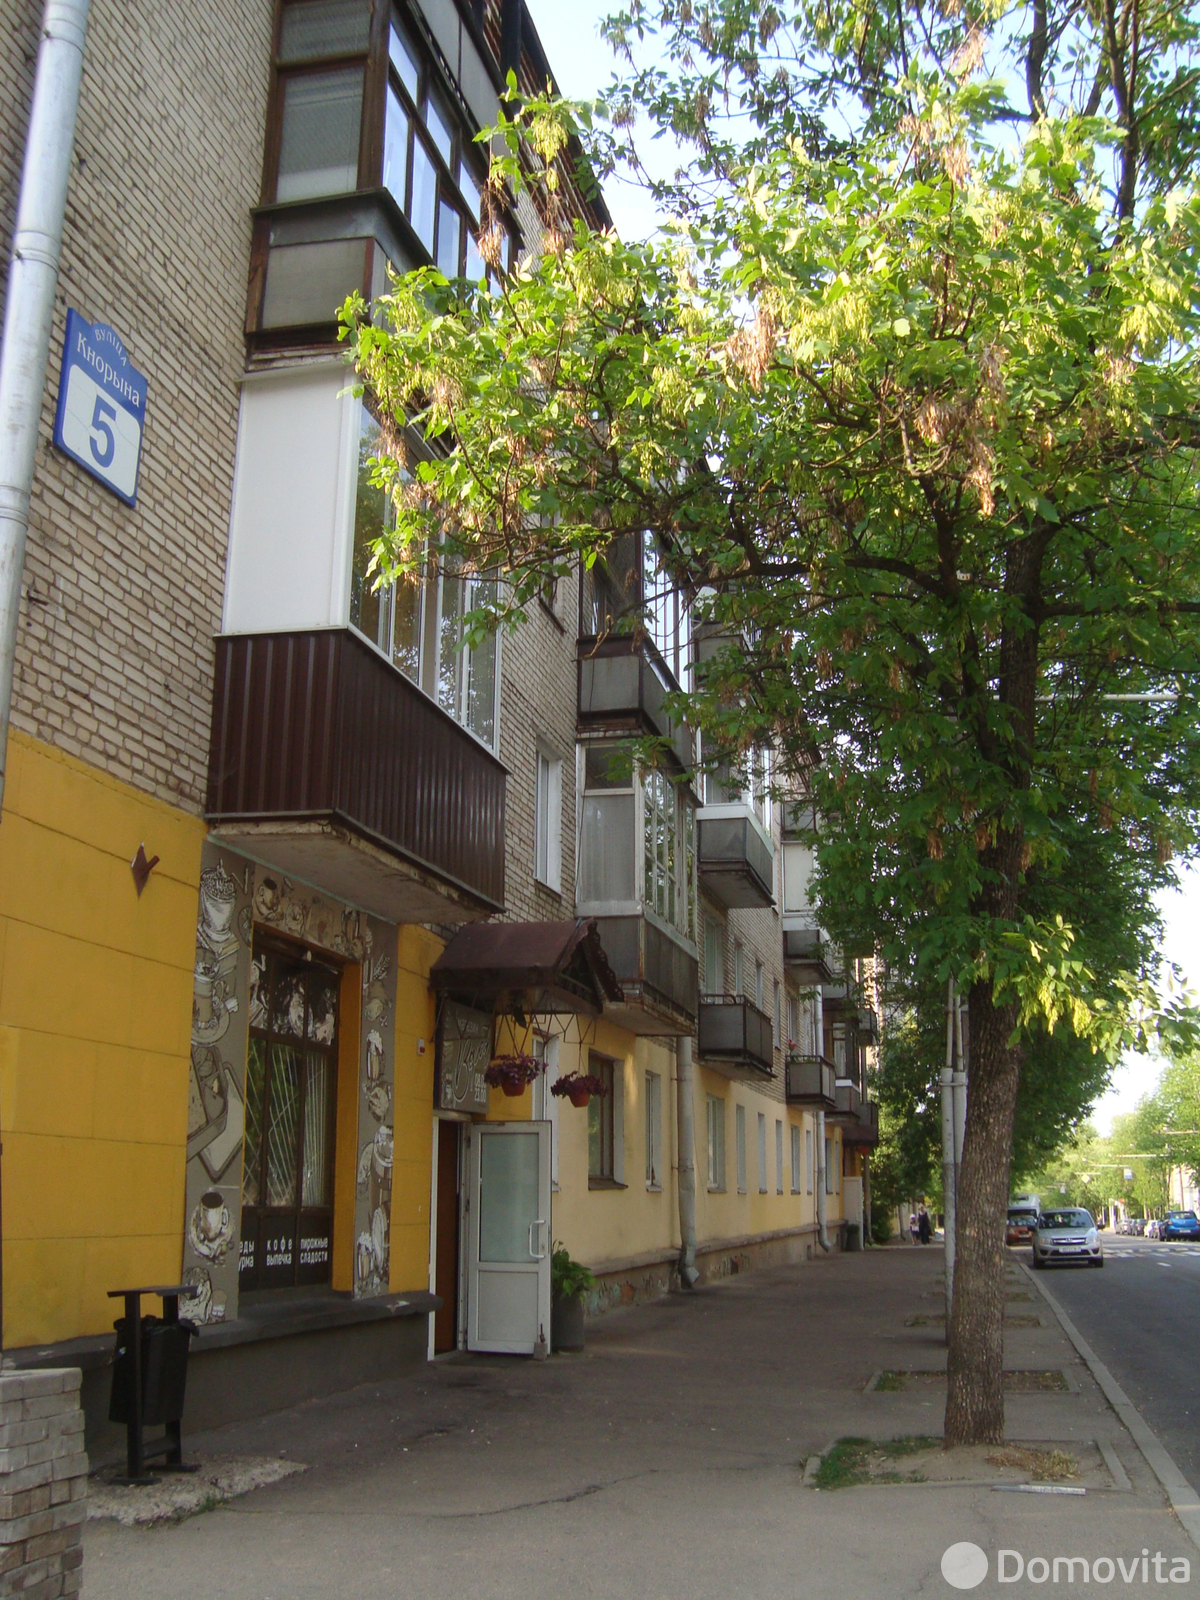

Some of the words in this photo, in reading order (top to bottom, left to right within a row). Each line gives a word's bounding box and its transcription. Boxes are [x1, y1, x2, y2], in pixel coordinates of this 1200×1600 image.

[77, 332, 140, 407] Кнорына
[89, 394, 117, 468] 5
[300, 1237, 328, 1252] пирожные
[266, 1252, 292, 1267] выпечка
[300, 1251, 328, 1265] сладости
